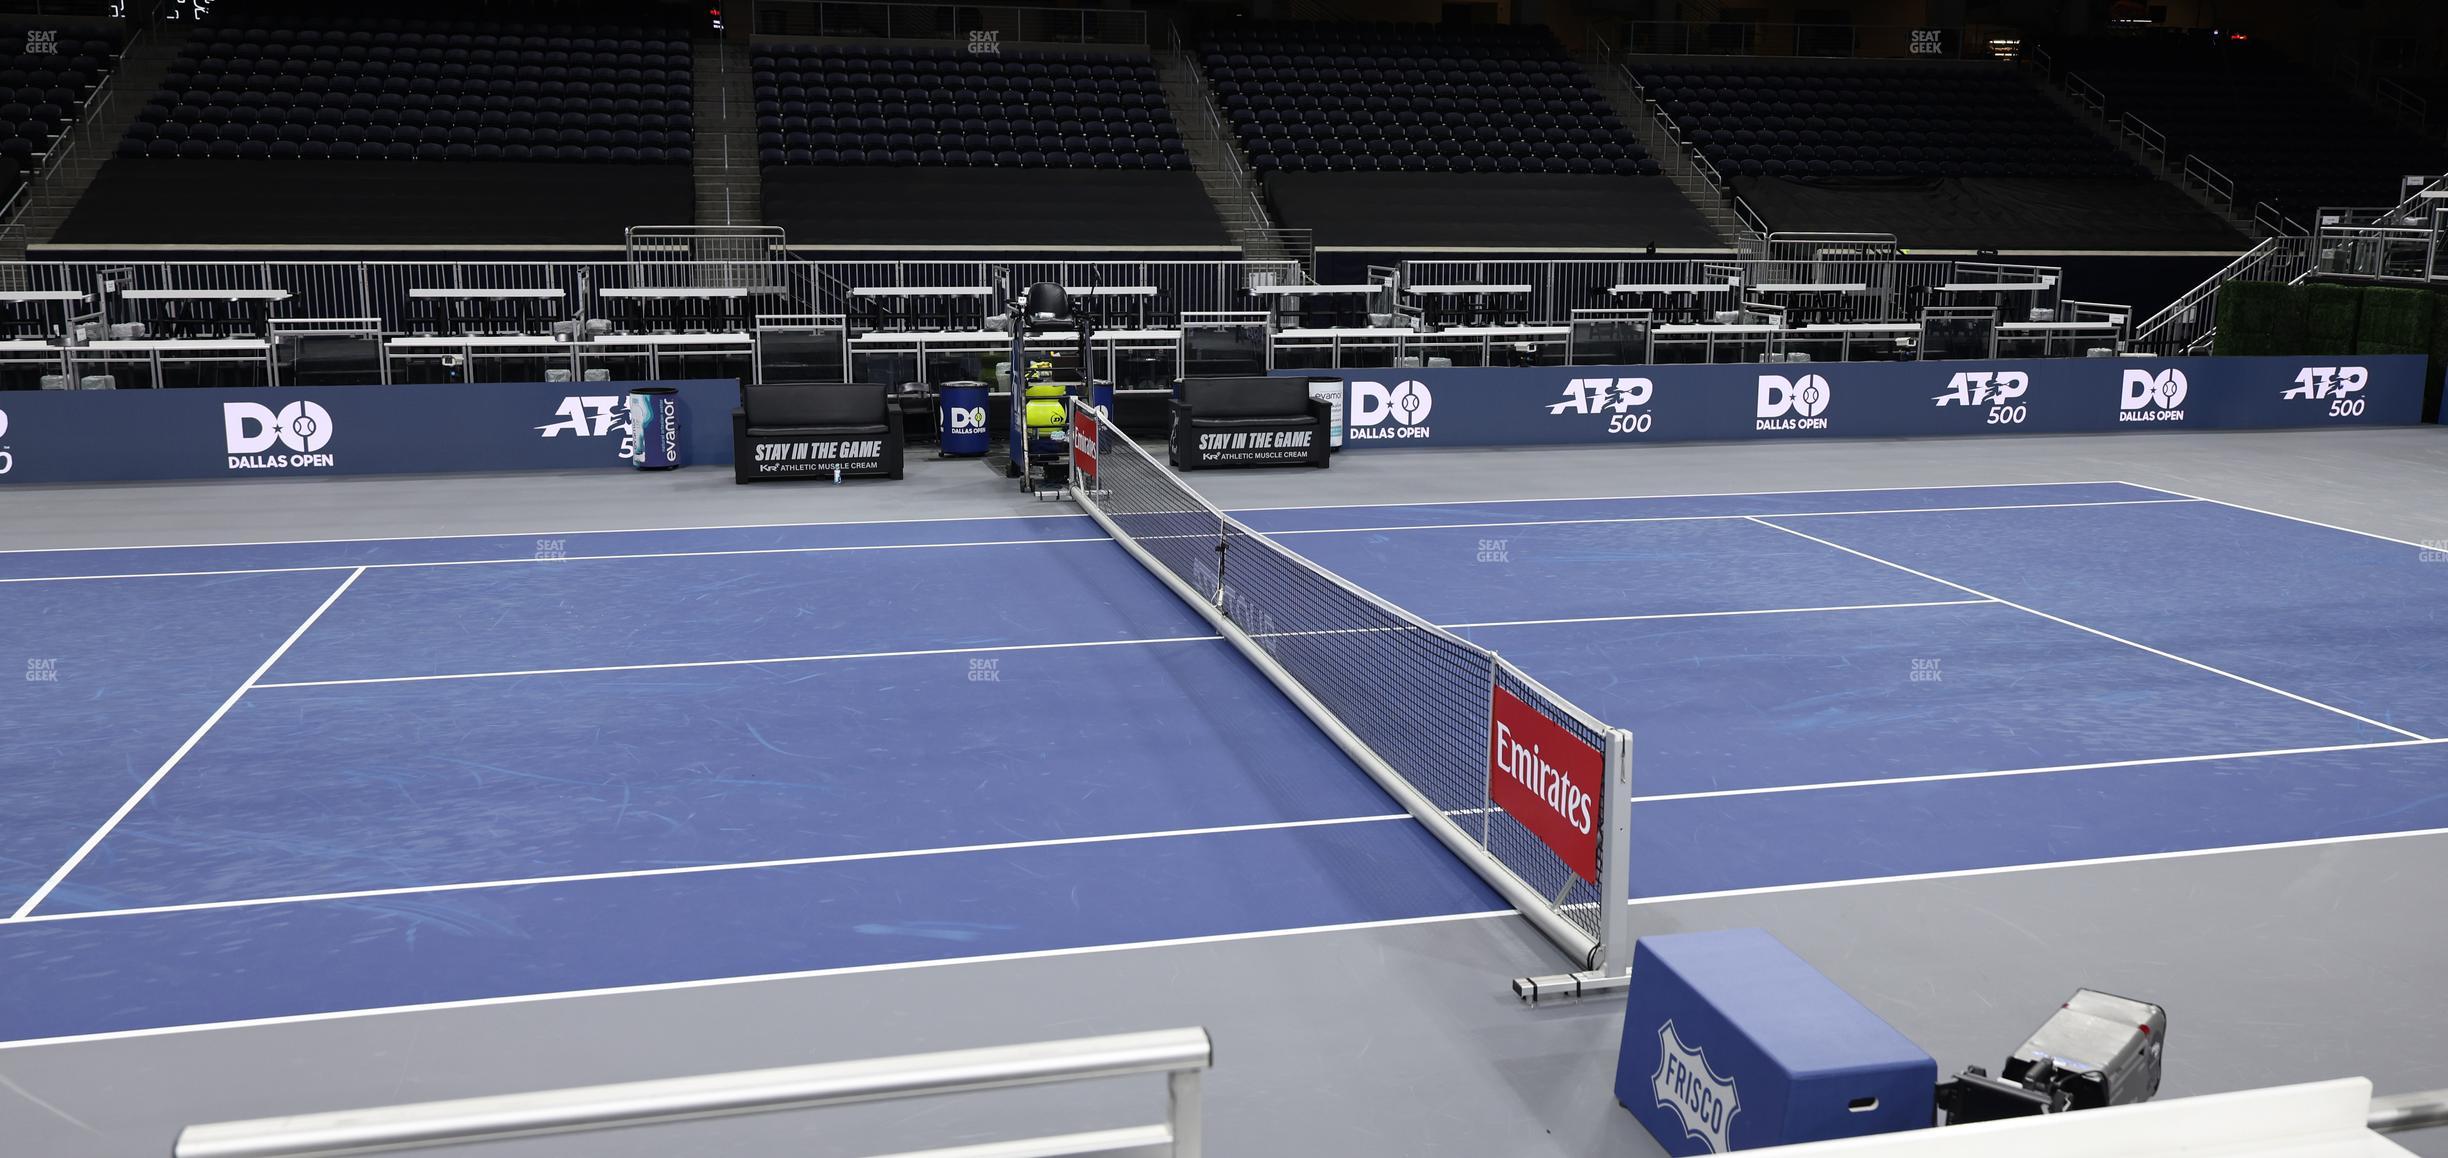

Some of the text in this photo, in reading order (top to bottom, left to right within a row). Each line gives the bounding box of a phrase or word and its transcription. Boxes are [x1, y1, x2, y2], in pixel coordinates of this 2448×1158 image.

[1930, 371, 2029, 406] ATP
[2279, 366, 2368, 400] ATP
[1314, 392, 1343, 400] evamo
[1544, 377, 1653, 415] ATP
[1987, 405, 2027, 424] 500
[2119, 410, 2184, 422] DALLAS OPEN
[2328, 399, 2365, 417] 500
[664, 398, 676, 462] evamor
[1350, 426, 1430, 439] DALLAS OPEN
[1607, 413, 1652, 433] 500
[1756, 418, 1828, 430] DALLAS OPEN
[1199, 430, 1313, 450] STAY IN THE GAME
[754, 440, 882, 461] STAY IN THE GAME
[1220, 452, 1254, 460] ATHLETIC
[228, 453, 334, 469] DALLAS OPEN
[780, 463, 817, 471] ATHLETIC
[850, 461, 878, 469] CREAM
[1497, 720, 1592, 834] Emirates
[1666, 1052, 1723, 1134] FRISCO
